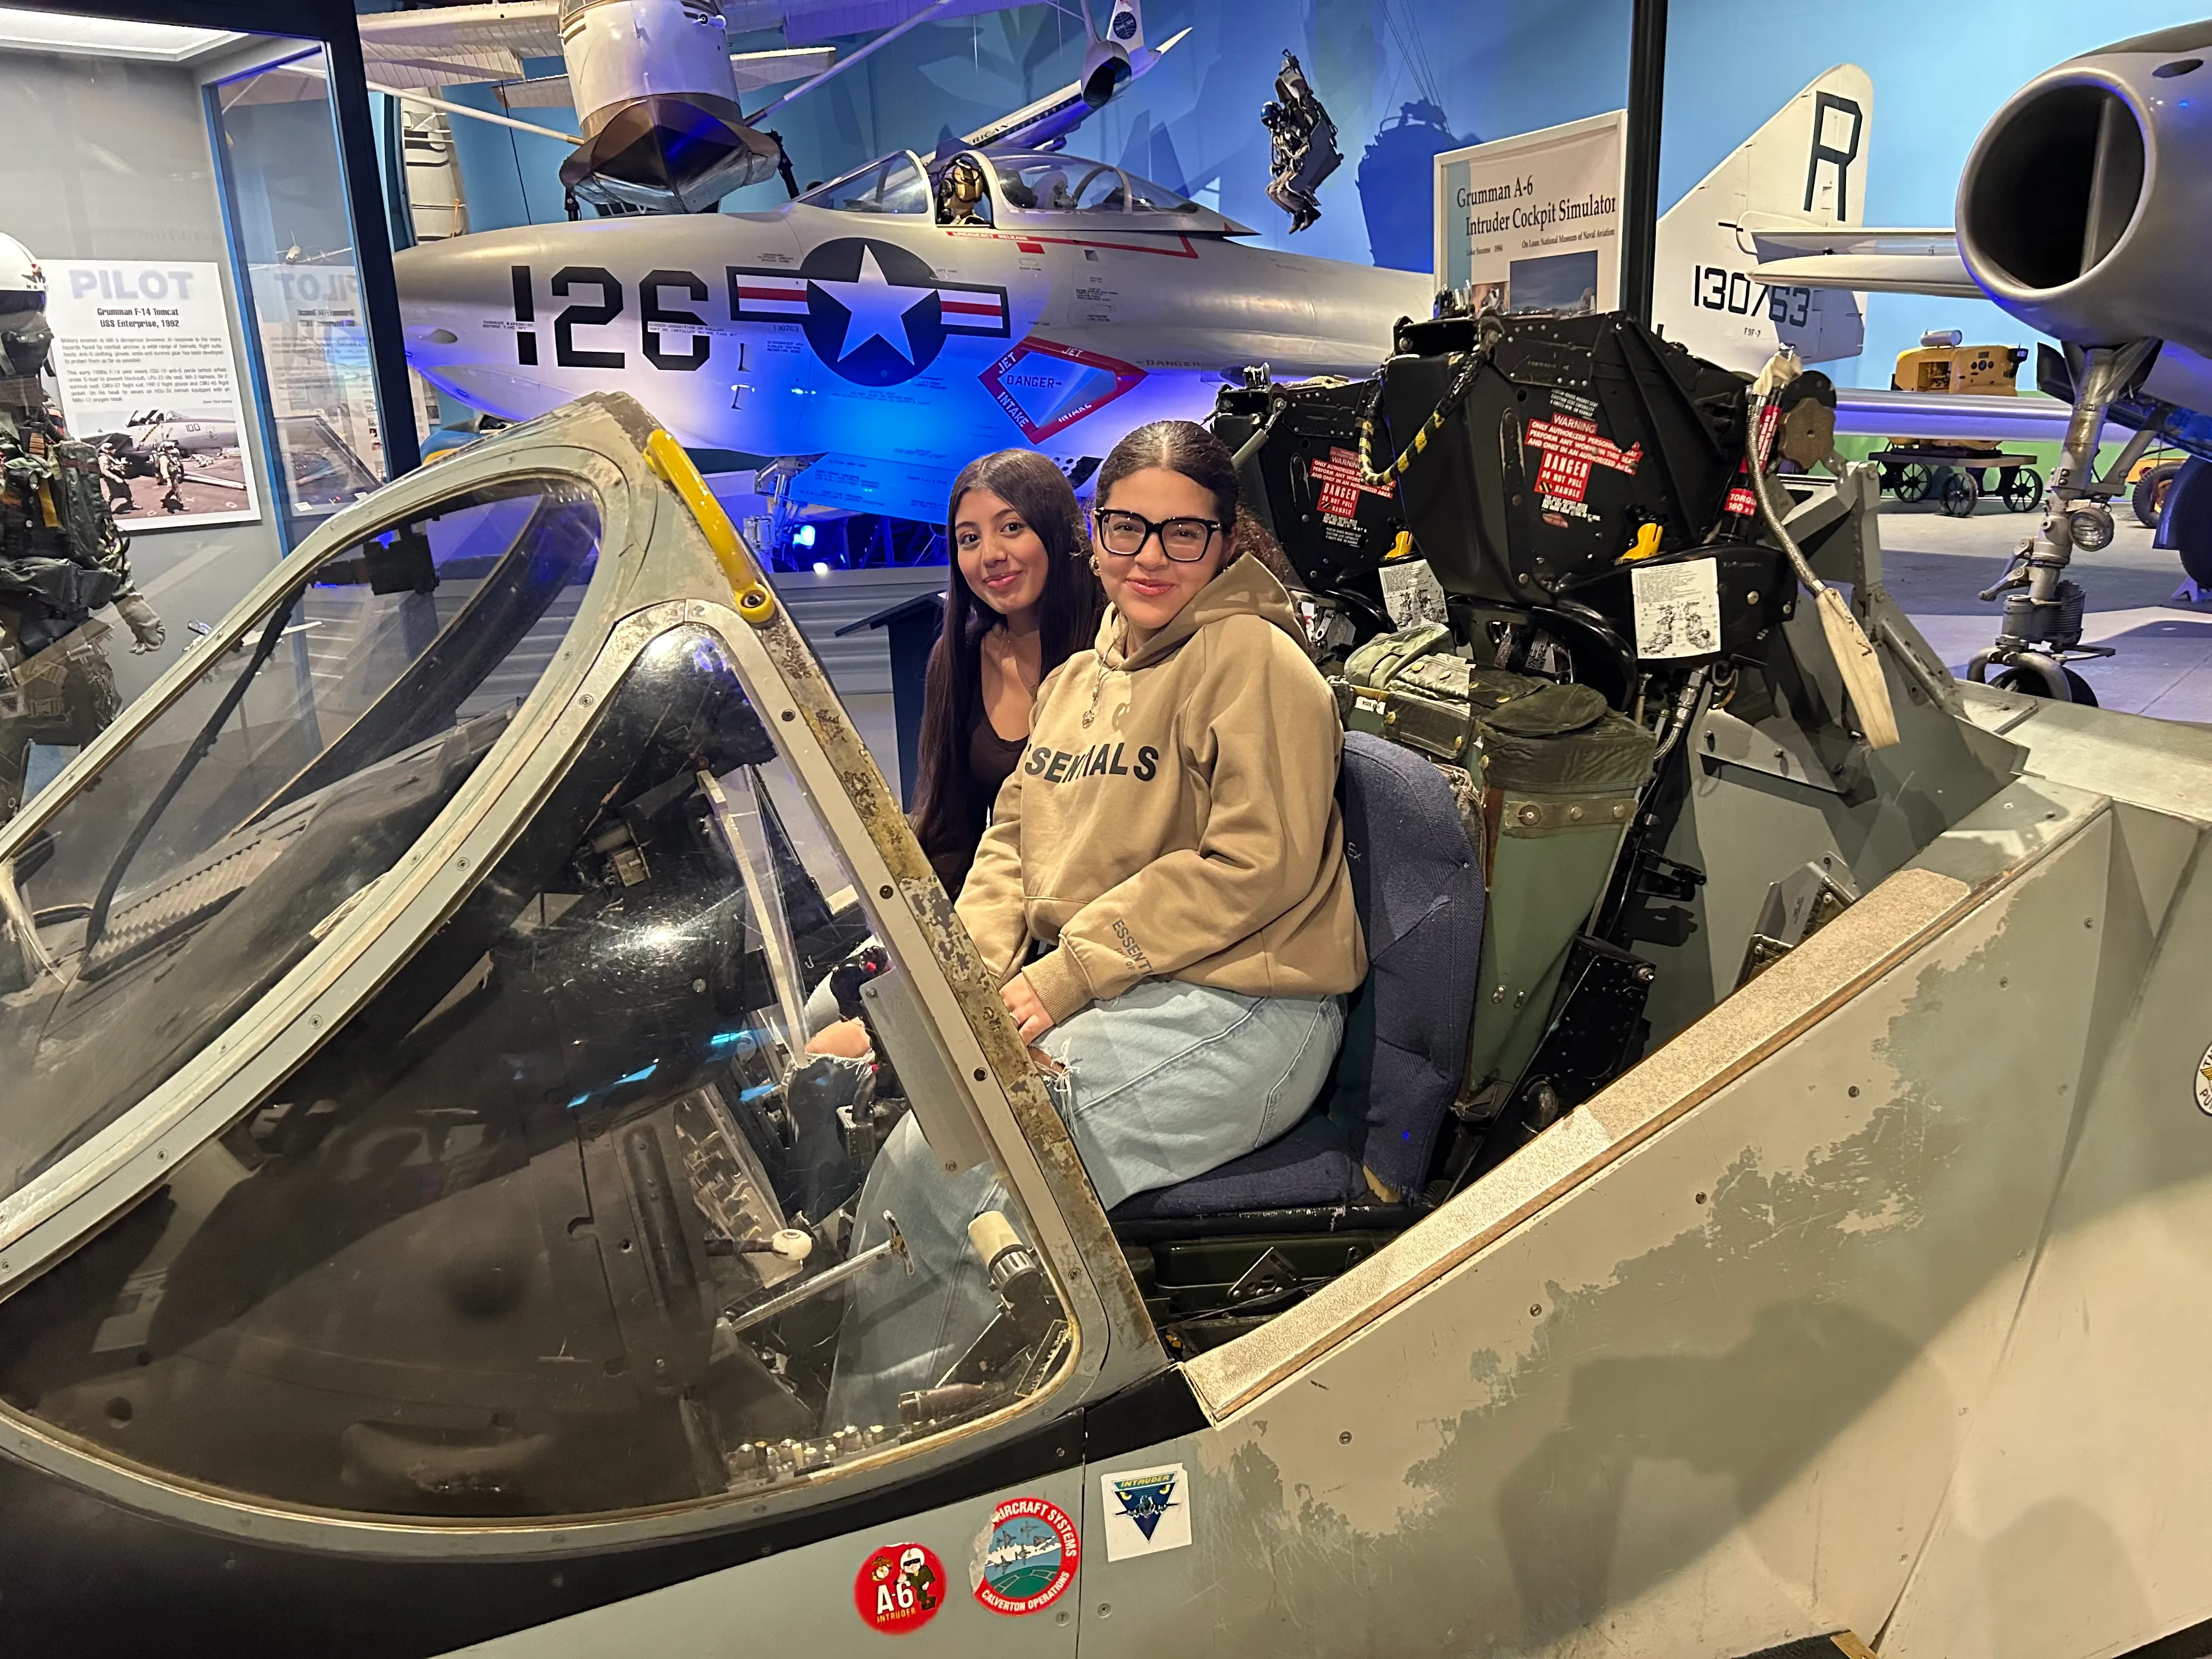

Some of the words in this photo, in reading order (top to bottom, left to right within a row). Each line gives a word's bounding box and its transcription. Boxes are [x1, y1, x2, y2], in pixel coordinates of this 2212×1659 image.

[1803, 90, 1863, 222] R
[1457, 184, 1510, 208] Grumman
[1514, 174, 1533, 198] A-6
[1466, 211, 1510, 236] Intruder
[1513, 202, 1556, 232] Cockpit
[1559, 193, 1616, 222] Simulator
[1541, 235, 1558, 245] National
[1559, 234, 1577, 243] Museum
[1578, 232, 1583, 240] of
[1583, 229, 1595, 239] Naval
[1596, 228, 1615, 238] Aviation
[69, 269, 193, 299] PILOT
[1694, 265, 1810, 328] 130763
[100, 319, 115, 328] USS
[117, 319, 159, 329] Enterprise,
[511, 266, 710, 371] 126
[1744, 328, 1761, 338] F9F-7
[1062, 346, 1084, 358] JET
[998, 352, 1017, 374] JET
[1007, 375, 1054, 388] DANGER
[996, 391, 1029, 428] INTAKE
[185, 424, 201, 432] 100
[1532, 421, 1548, 431] ONLY
[1548, 425, 1586, 441] AUTHORIZED
[1554, 415, 1596, 433] WARNING
[1527, 438, 1543, 447] AND
[1543, 442, 1560, 453] ONLY
[1568, 448, 1578, 457] AN
[1579, 451, 1615, 467] AUTHORIZED
[1530, 429, 1558, 442] PERFORM
[1559, 438, 1573, 446] ANY
[1607, 451, 1620, 460] THIS
[1312, 466, 1334, 476] PERFORM
[1327, 464, 1355, 475] AUTHORIZED
[1544, 453, 1588, 478] DANGER
[1541, 470, 1551, 479] DO
[1553, 473, 1566, 483] NOT
[1567, 477, 1582, 488] PULL
[1323, 483, 1357, 501] DANGER
[1350, 482, 1378, 494] AUTHORIZED
[1378, 489, 1391, 498] AREA
[1554, 484, 1581, 498] HANDLE
[1330, 497, 1340, 505] NOT
[1341, 500, 1353, 508] PULL
[1730, 493, 1757, 506] TORQU
[1331, 505, 1352, 515] HANDLE
[1112, 918, 1154, 975] ESSENTI
[1120, 1475, 1170, 1487] INTRUDER
[1047, 1509, 1077, 1557] SYSTEMS
[877, 1581, 914, 1615] A-6
[981, 1589, 1026, 1611] CALVERTON
[1028, 1571, 1070, 1610] OPERATIONS
[877, 1607, 916, 1624] INTRUDER
